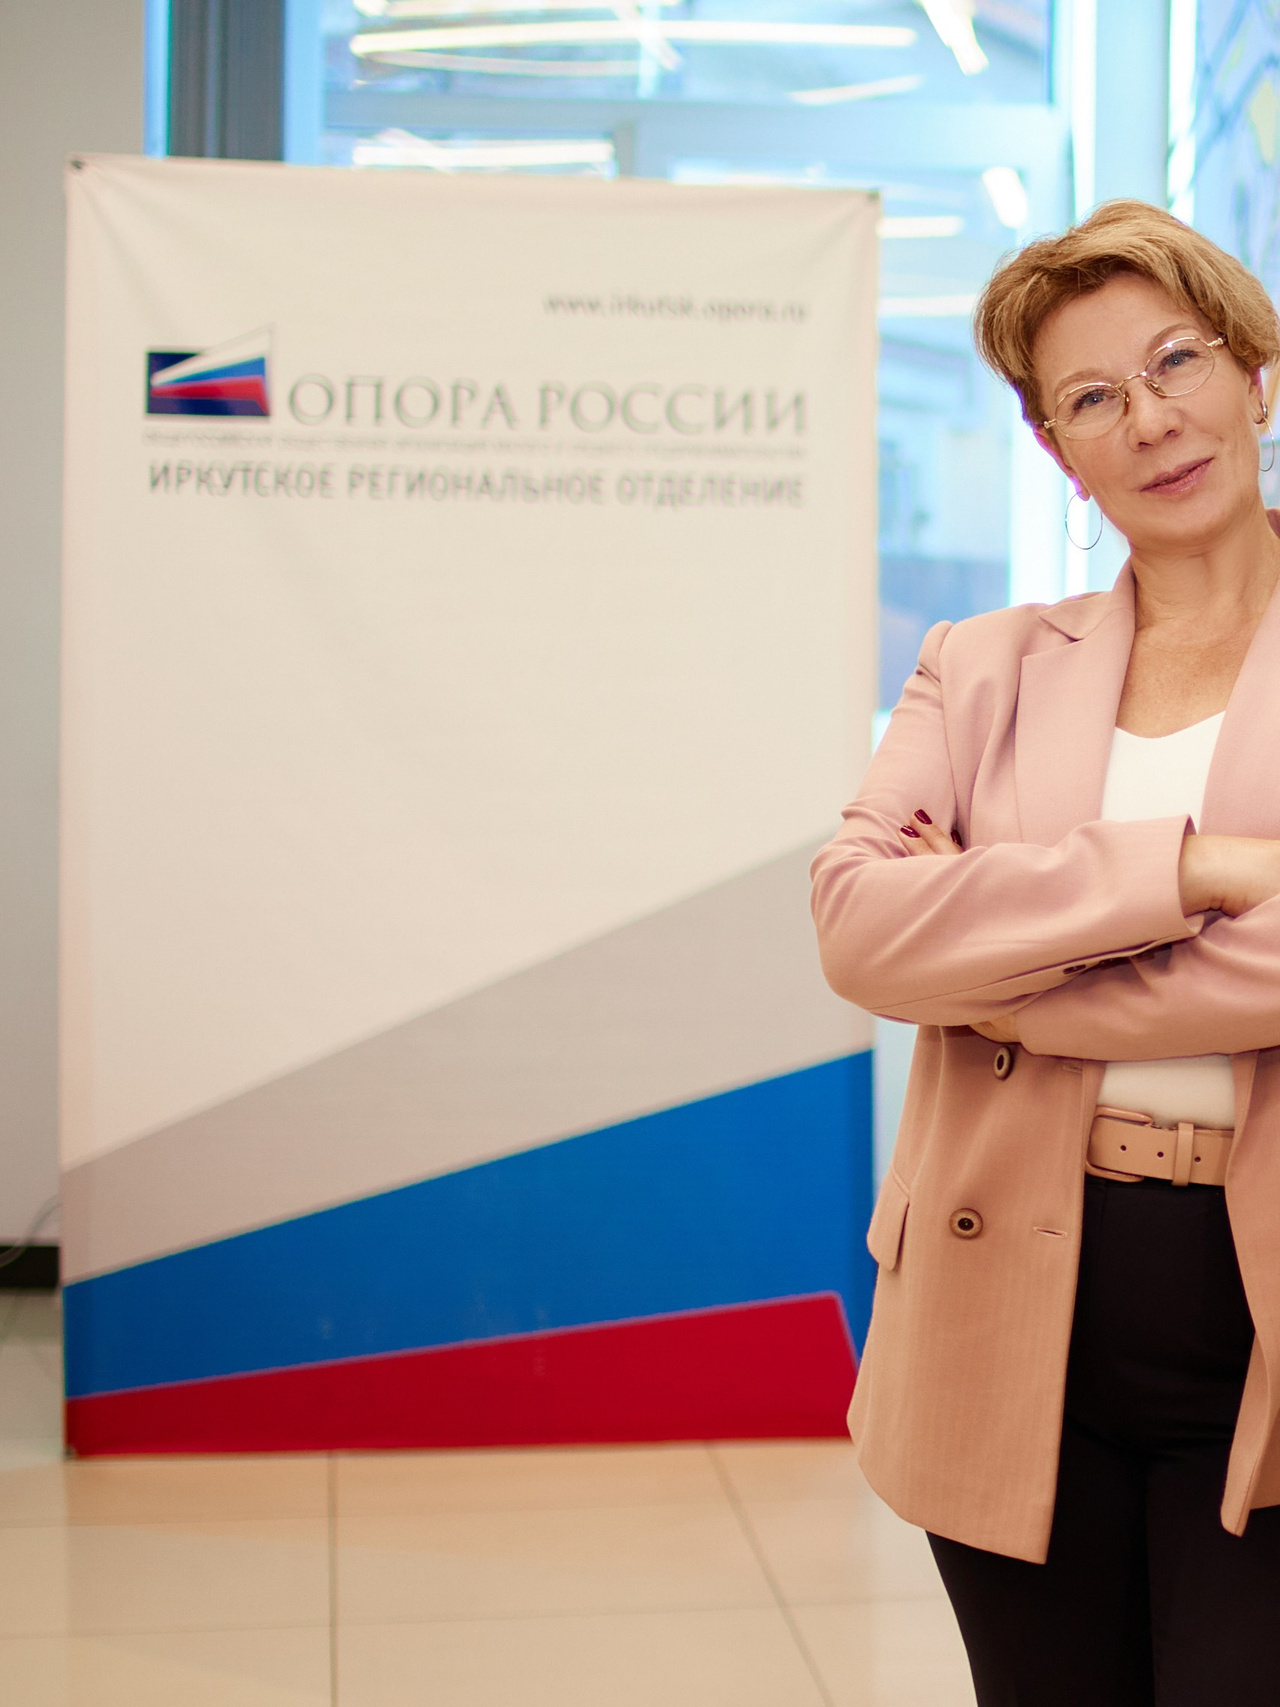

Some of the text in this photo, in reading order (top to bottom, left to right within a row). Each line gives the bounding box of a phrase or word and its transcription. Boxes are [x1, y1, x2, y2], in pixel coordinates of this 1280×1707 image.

[286, 372, 806, 437] ОПОРА РОССИИ
[148, 459, 807, 510] ИРКУТСКОЕ РЕГИОНАЛЬНОЕ ОТДЕЛЕНИЕ
